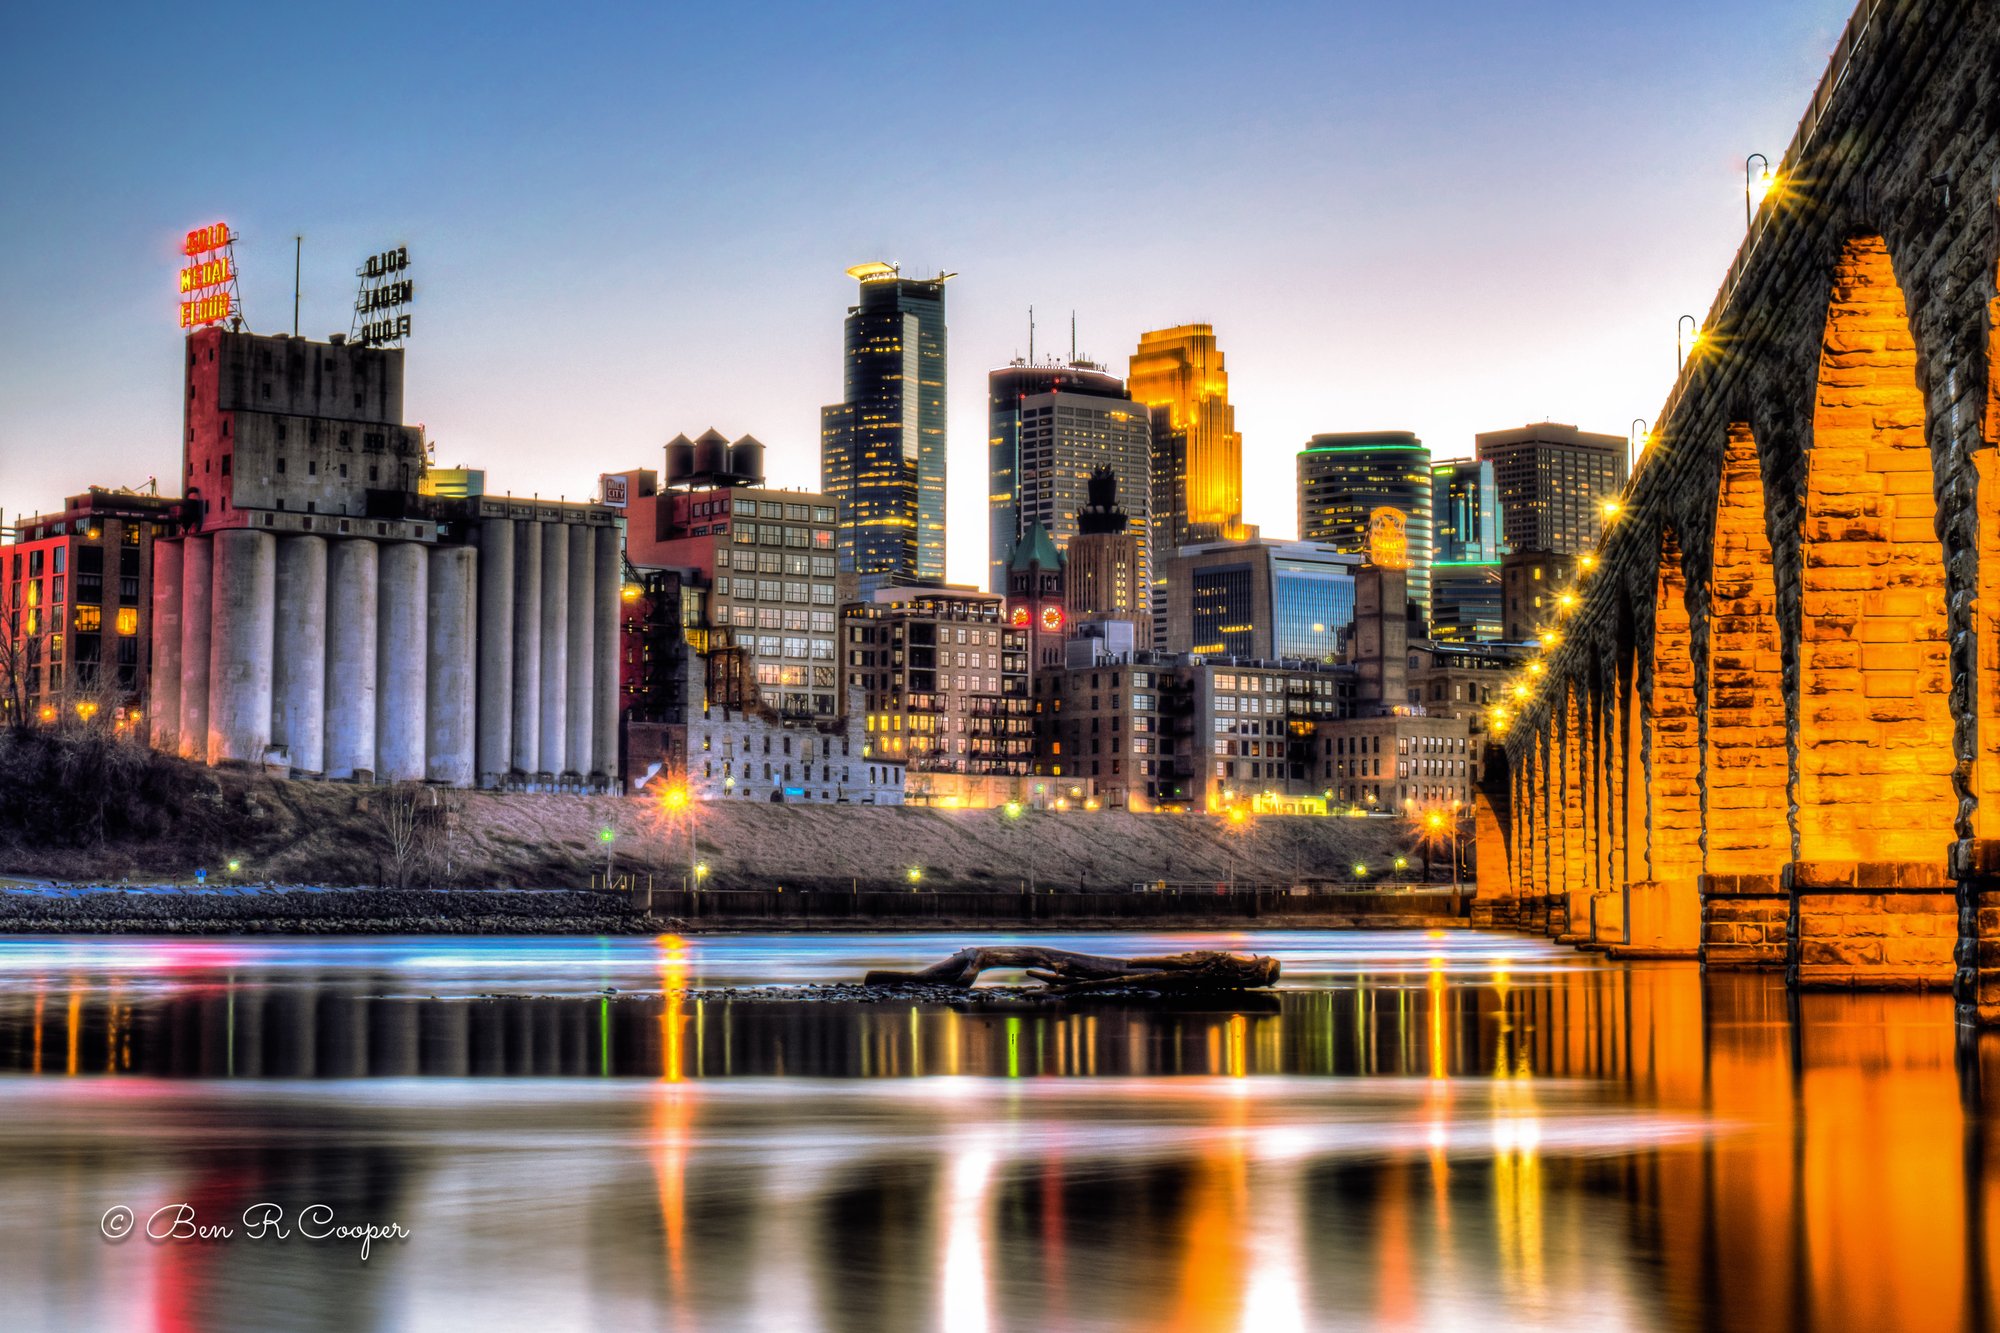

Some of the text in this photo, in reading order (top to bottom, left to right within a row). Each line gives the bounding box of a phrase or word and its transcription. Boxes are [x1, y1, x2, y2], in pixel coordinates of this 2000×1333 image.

[186, 222, 228, 256] GOLD
[181, 257, 233, 293] MEDAL
[181, 292, 230, 328] FLOUR
[607, 480, 625, 490] MILL
[607, 489, 625, 498] CITY
